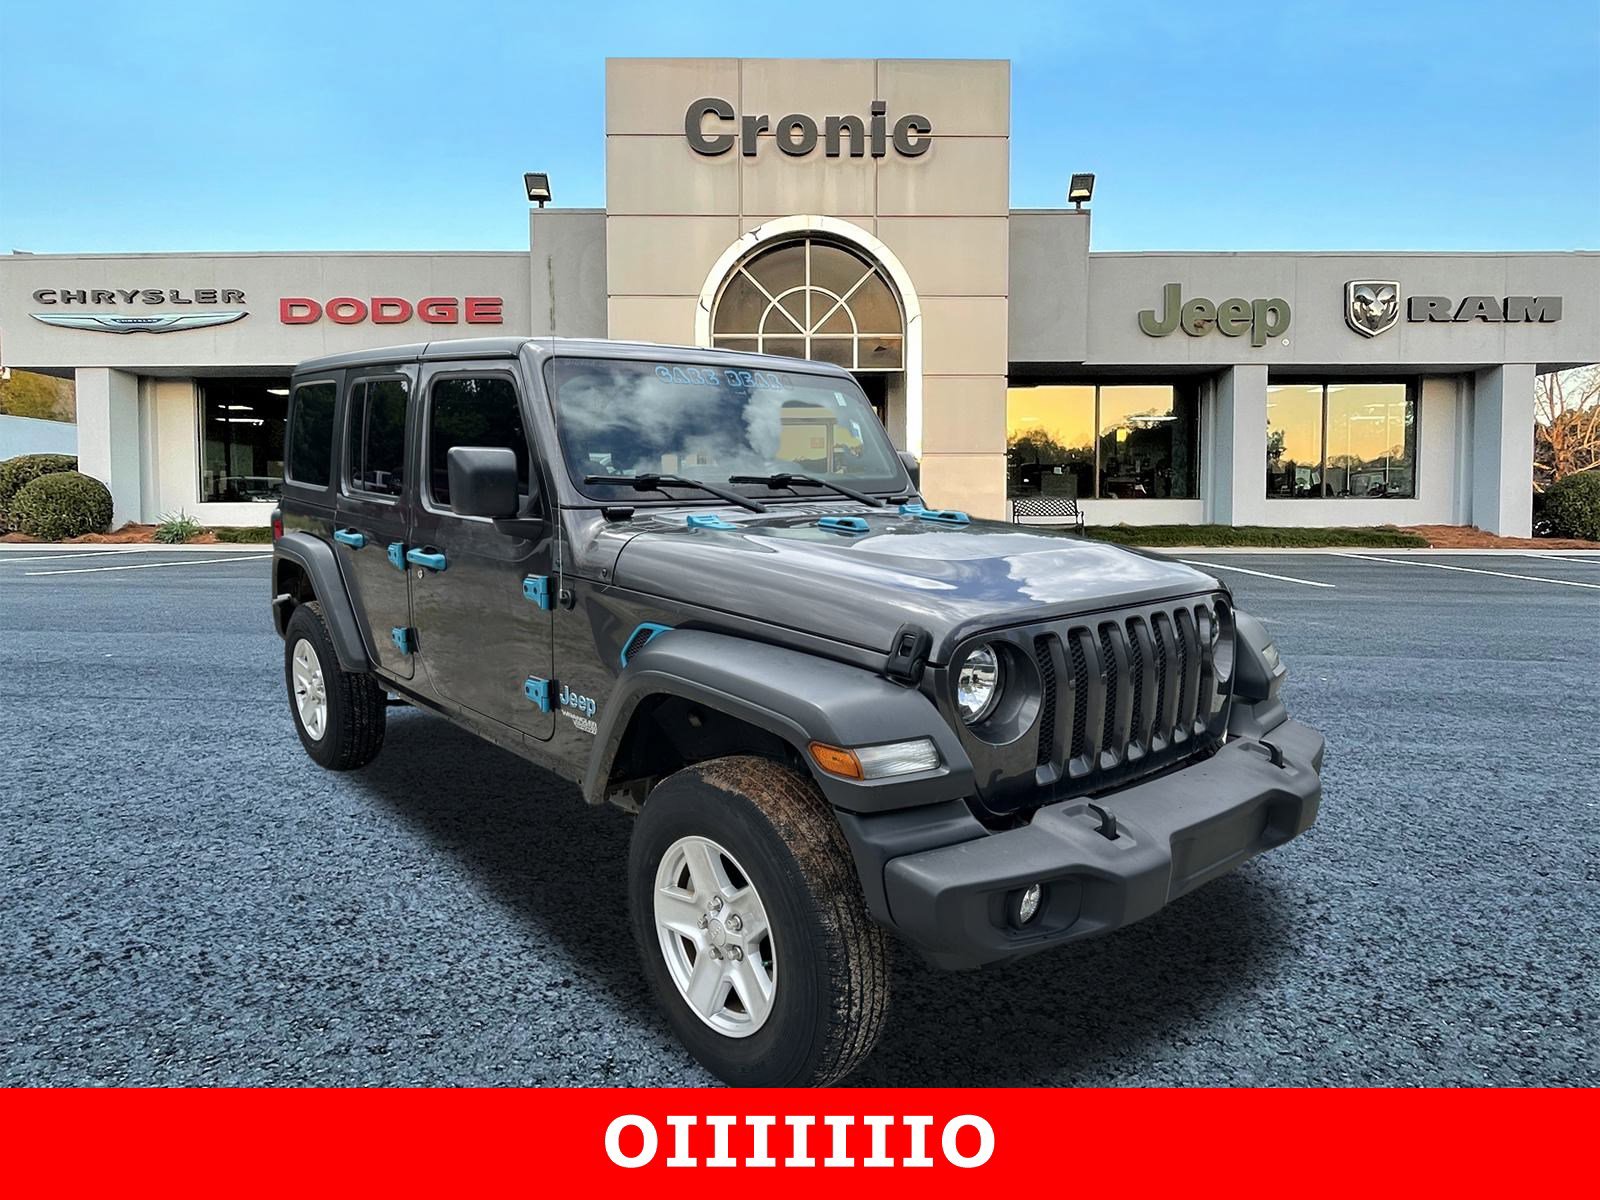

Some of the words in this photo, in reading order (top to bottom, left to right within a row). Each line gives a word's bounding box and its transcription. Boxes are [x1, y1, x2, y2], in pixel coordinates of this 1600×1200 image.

[684, 97, 932, 158] Cronic
[32, 288, 247, 305] CHRYSLER
[279, 297, 503, 325] DODGE
[1407, 296, 1562, 323] RAM
[1138, 282, 1291, 348] Jeep
[559, 685, 597, 718] Jeep
